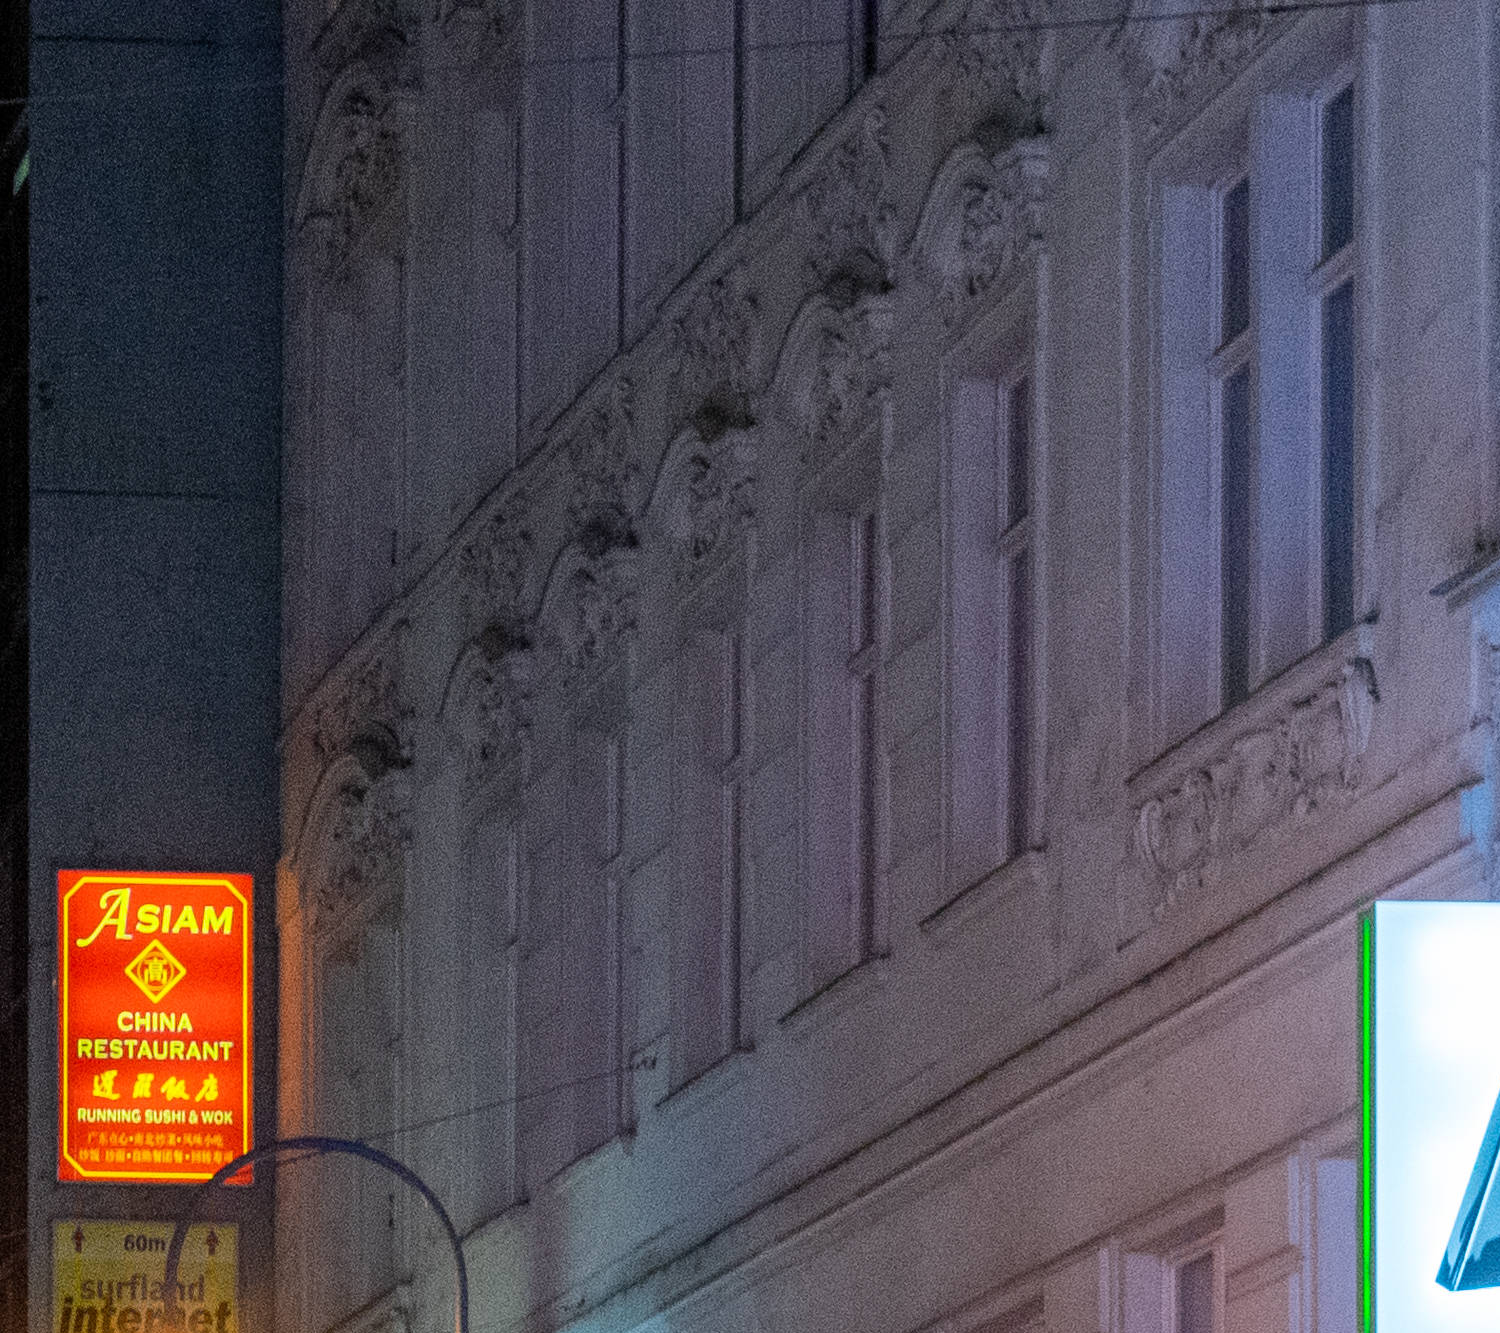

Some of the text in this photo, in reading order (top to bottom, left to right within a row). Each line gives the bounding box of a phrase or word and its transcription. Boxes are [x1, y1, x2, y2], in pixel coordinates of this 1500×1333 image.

[76, 887, 235, 948] ASIAM
[116, 1011, 193, 1033] CHINA
[76, 1038, 235, 1062] RESTAURANT
[77, 1107, 234, 1126] RUNNING SUSHI & WOK
[123, 1234, 167, 1251] 60m
